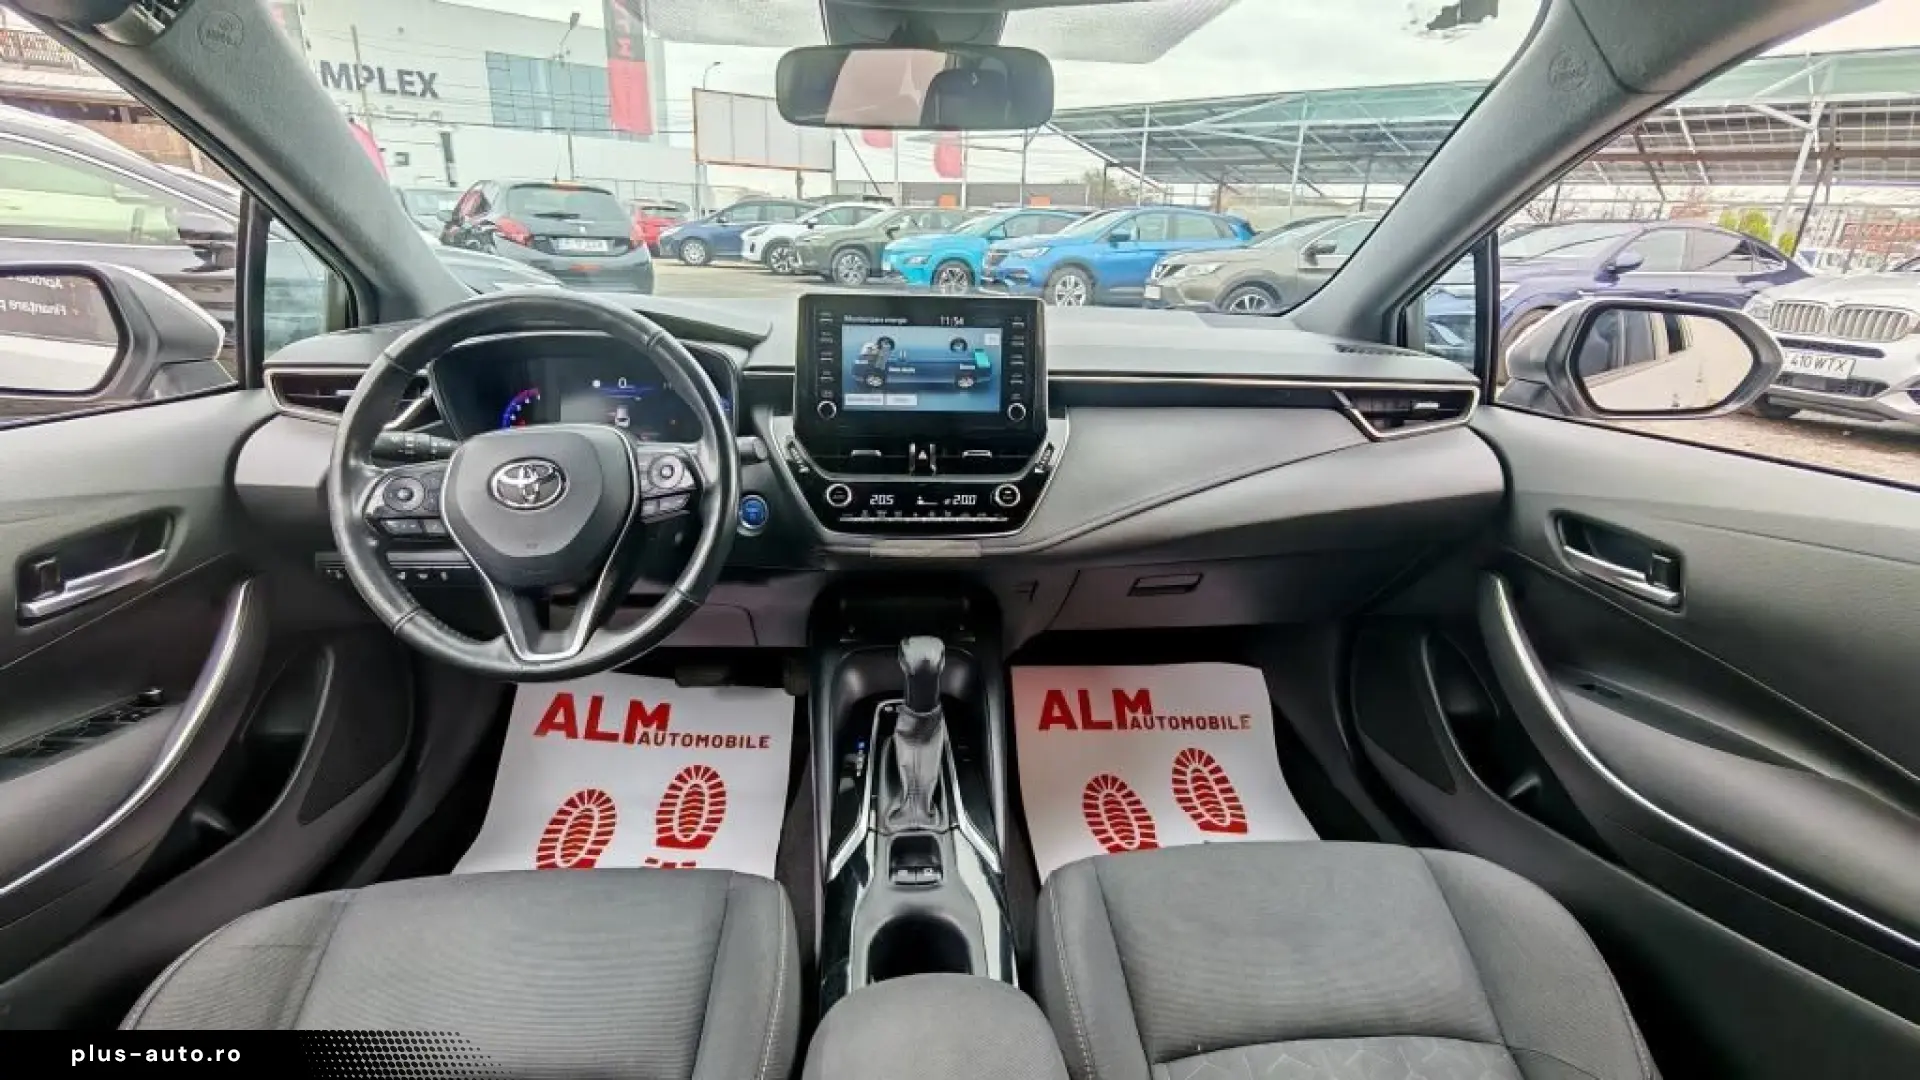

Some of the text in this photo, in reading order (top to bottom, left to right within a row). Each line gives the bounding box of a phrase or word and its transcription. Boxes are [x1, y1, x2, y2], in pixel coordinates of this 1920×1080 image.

[313, 59, 440, 99] MPLEX
[533, 691, 772, 749] ALM AUTOMOBILE
[1038, 687, 1252, 731] ALM AUTOMOBILE
